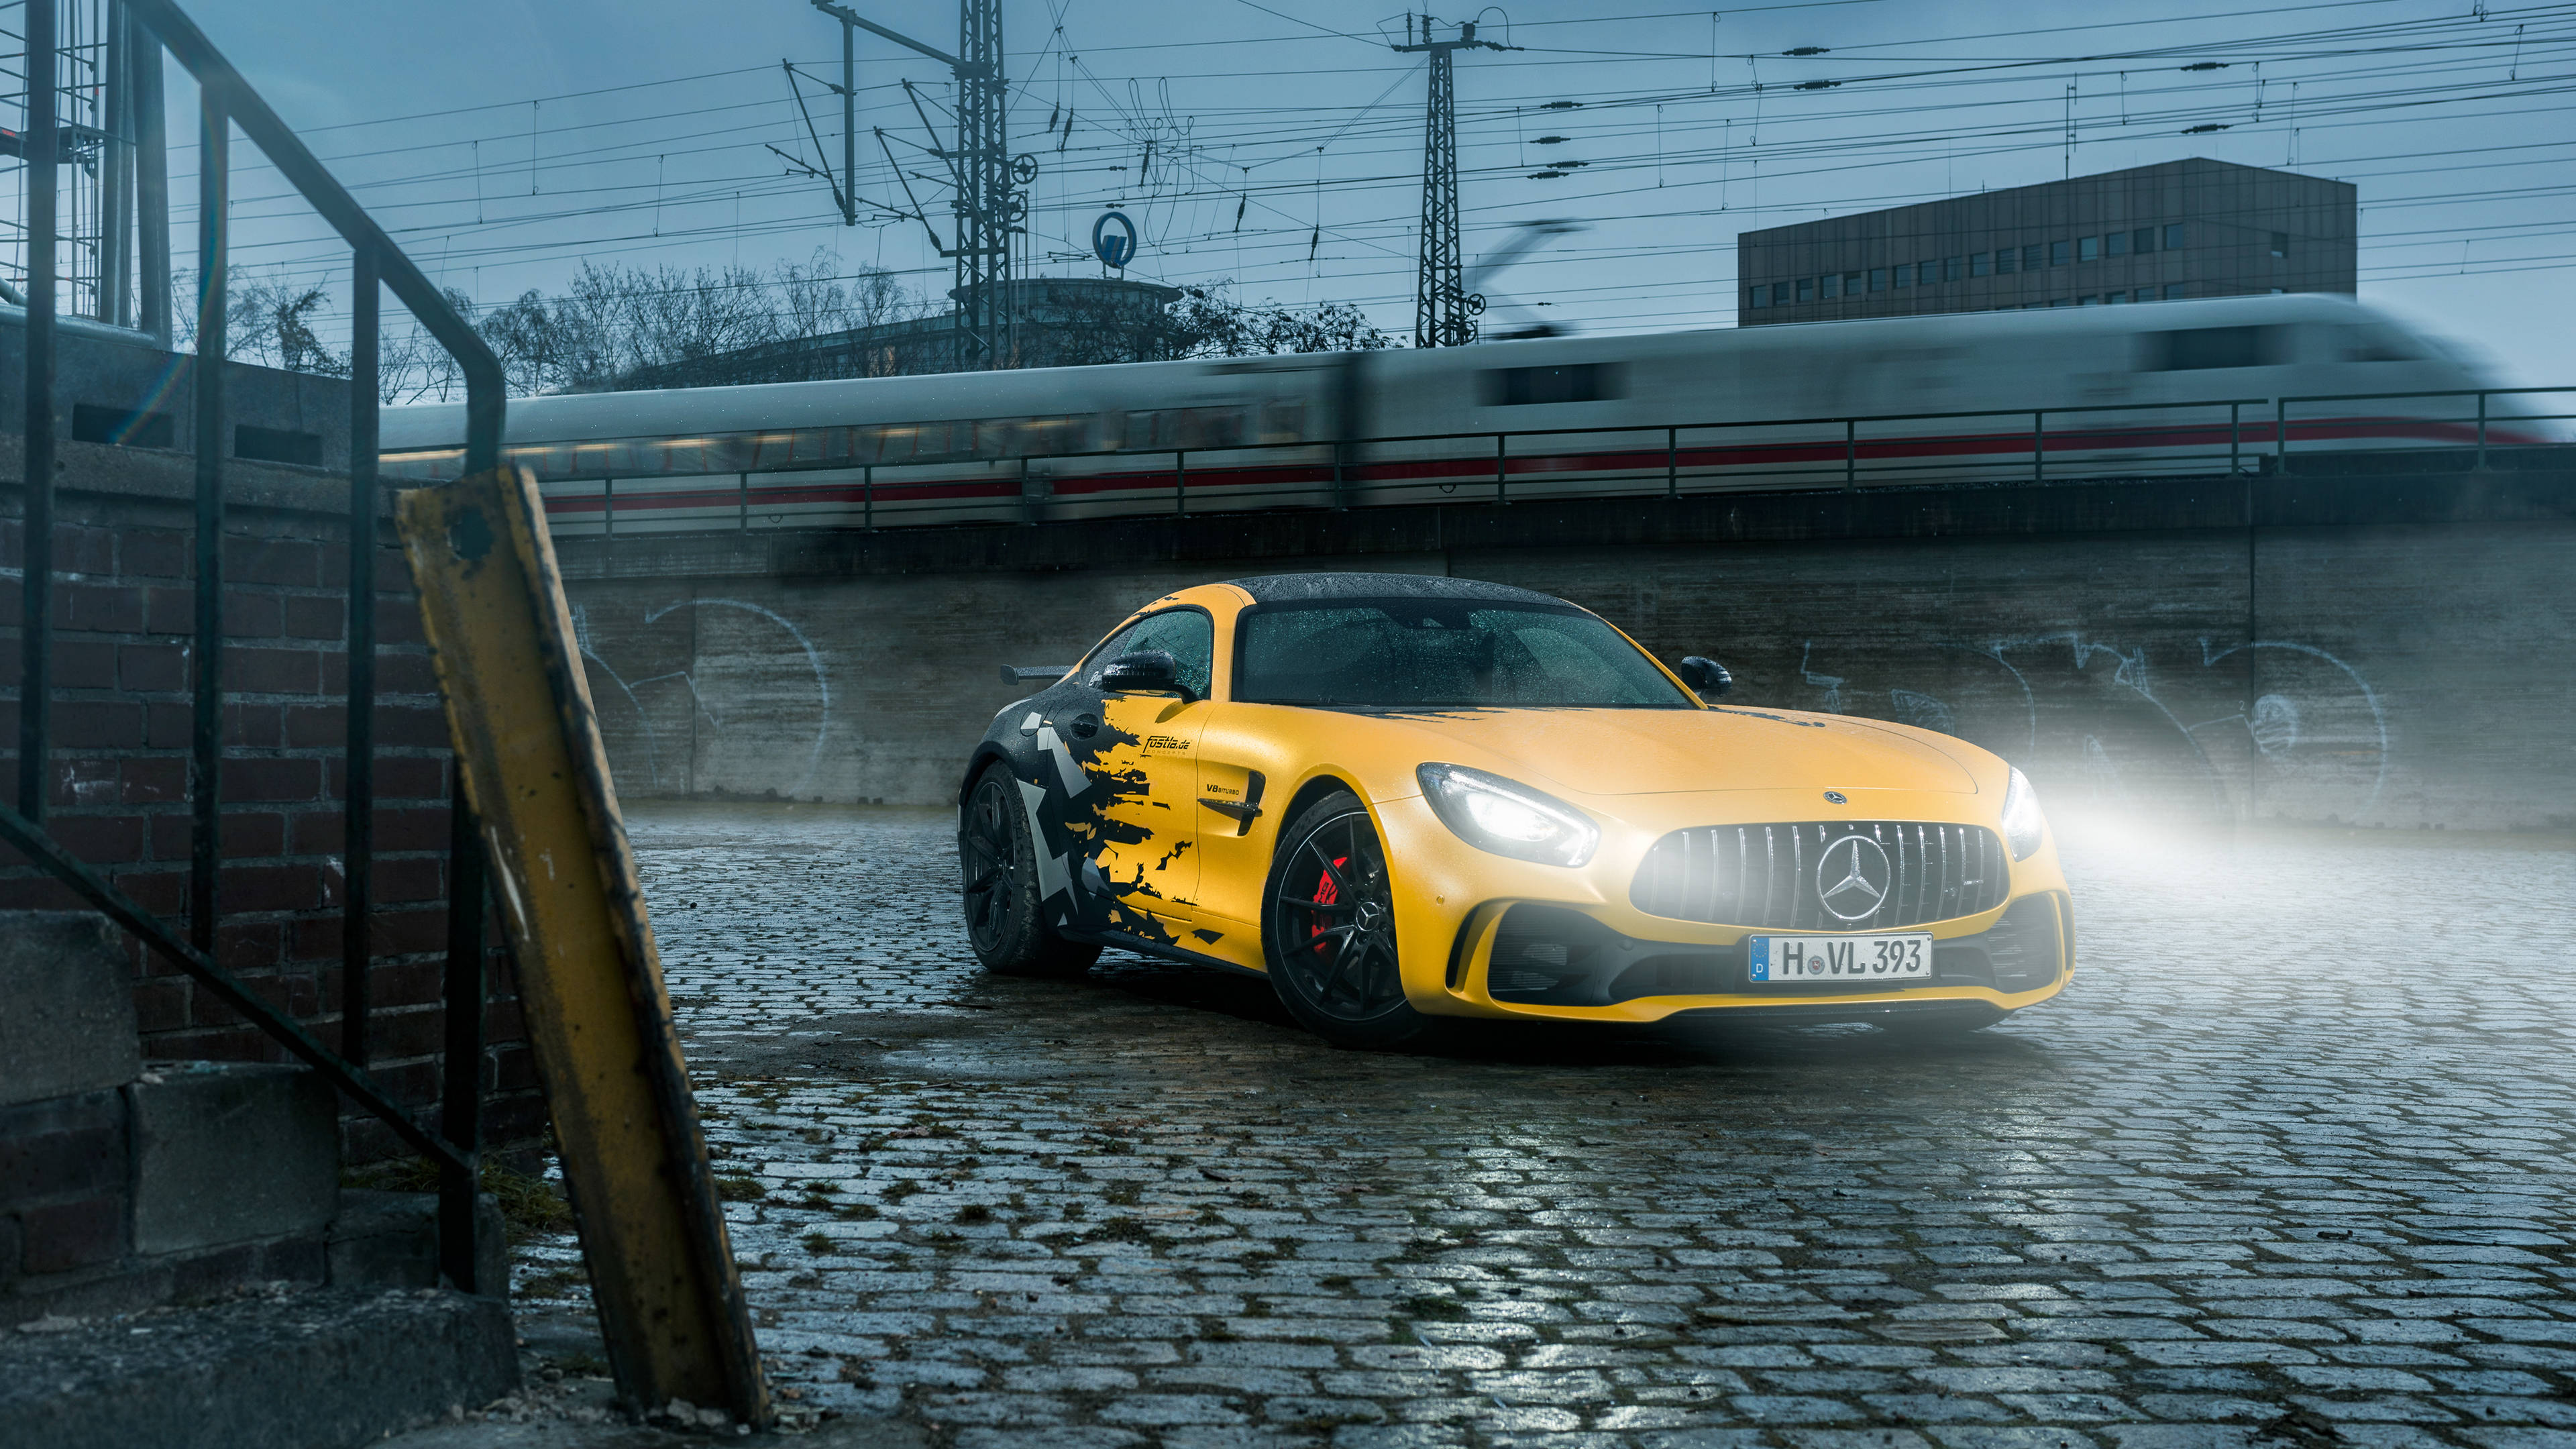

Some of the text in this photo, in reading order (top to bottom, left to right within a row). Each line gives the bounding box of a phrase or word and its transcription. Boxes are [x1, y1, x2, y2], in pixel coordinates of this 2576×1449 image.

[1207, 784, 1240, 796] V8 BITURBO
[1783, 941, 1804, 975] H
[1756, 963, 1764, 973] D
